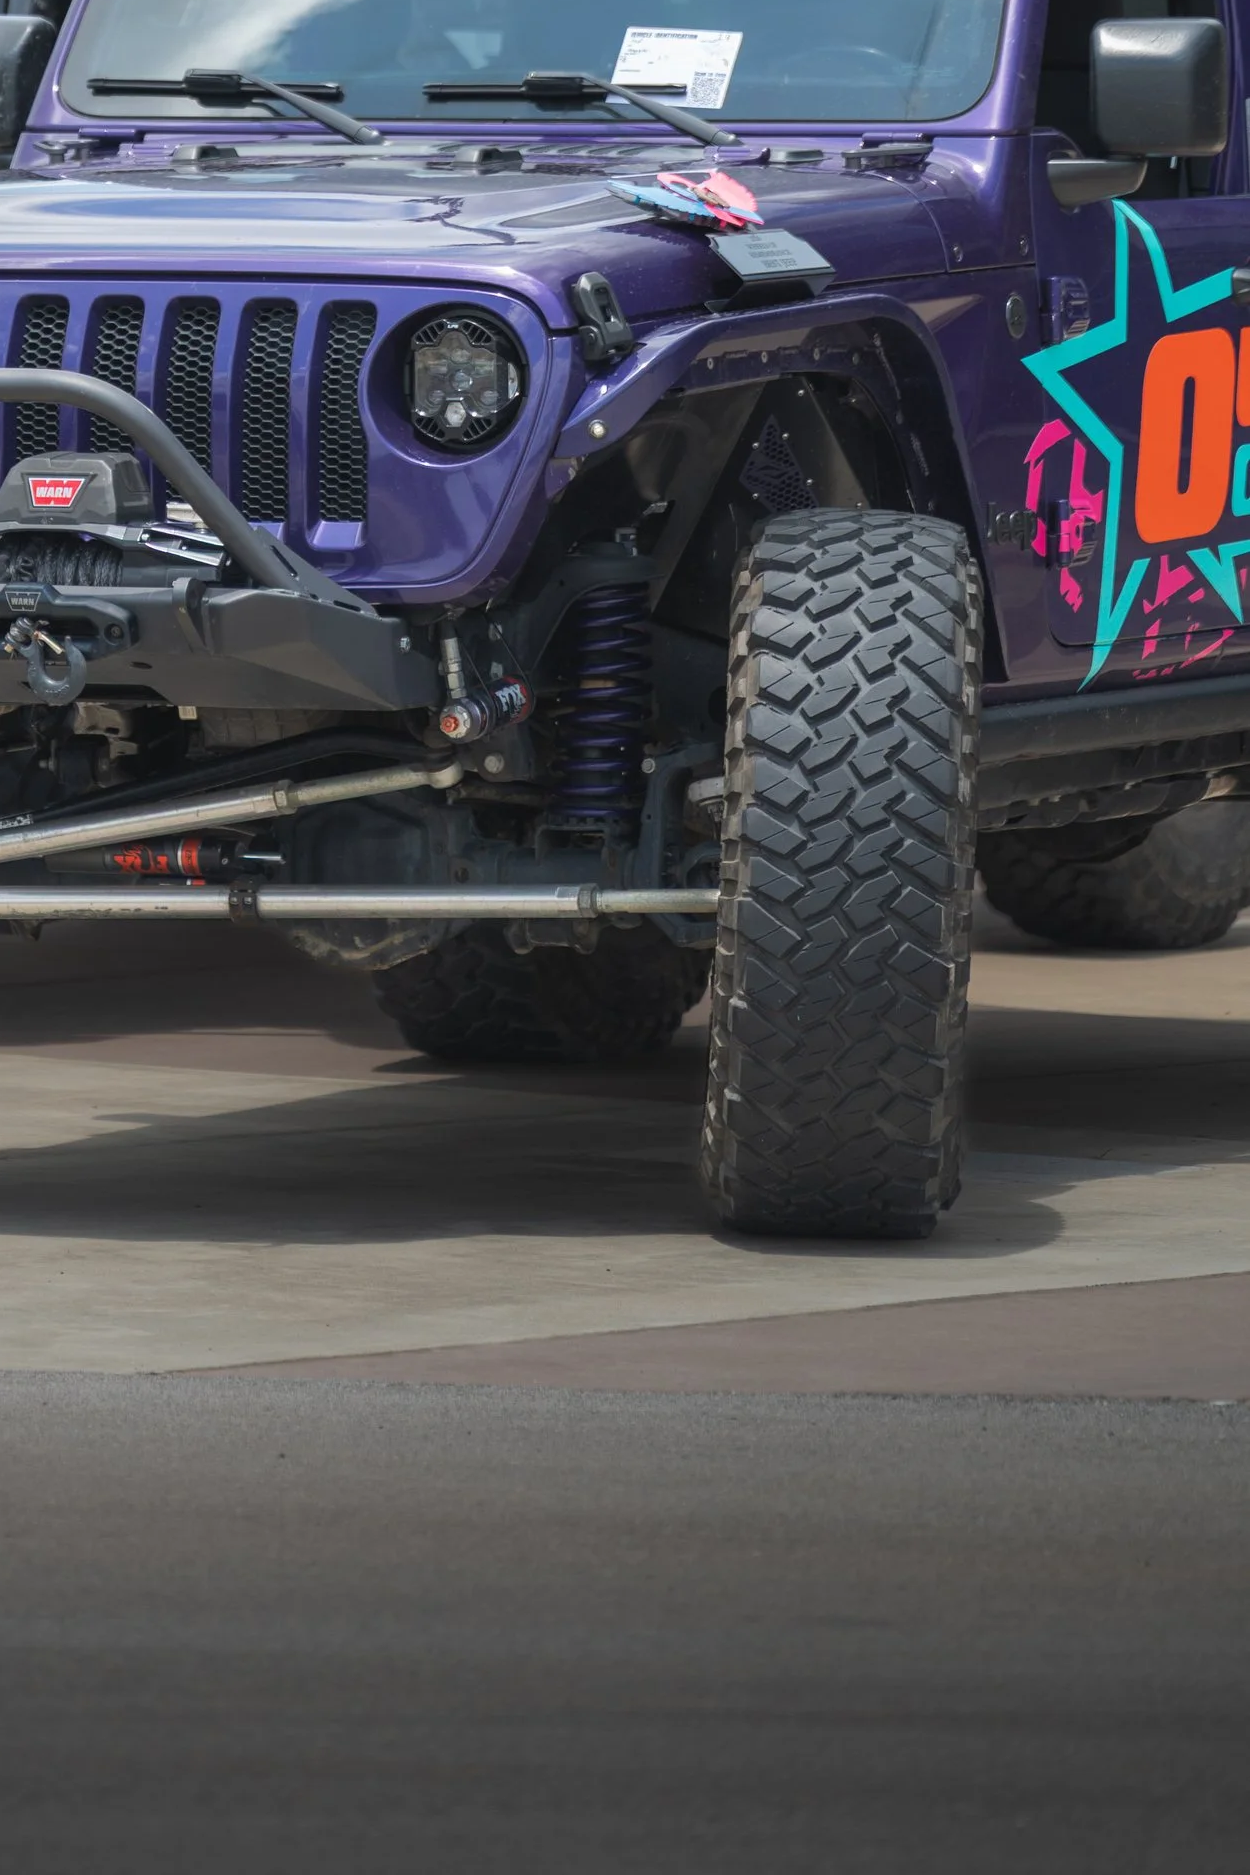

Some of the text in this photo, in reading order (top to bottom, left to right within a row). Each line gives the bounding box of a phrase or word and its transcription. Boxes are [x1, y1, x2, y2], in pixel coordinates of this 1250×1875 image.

[35, 486, 73, 498] WARN
[987, 502, 1038, 550] Jeep
[10, 597, 35, 606] WARN
